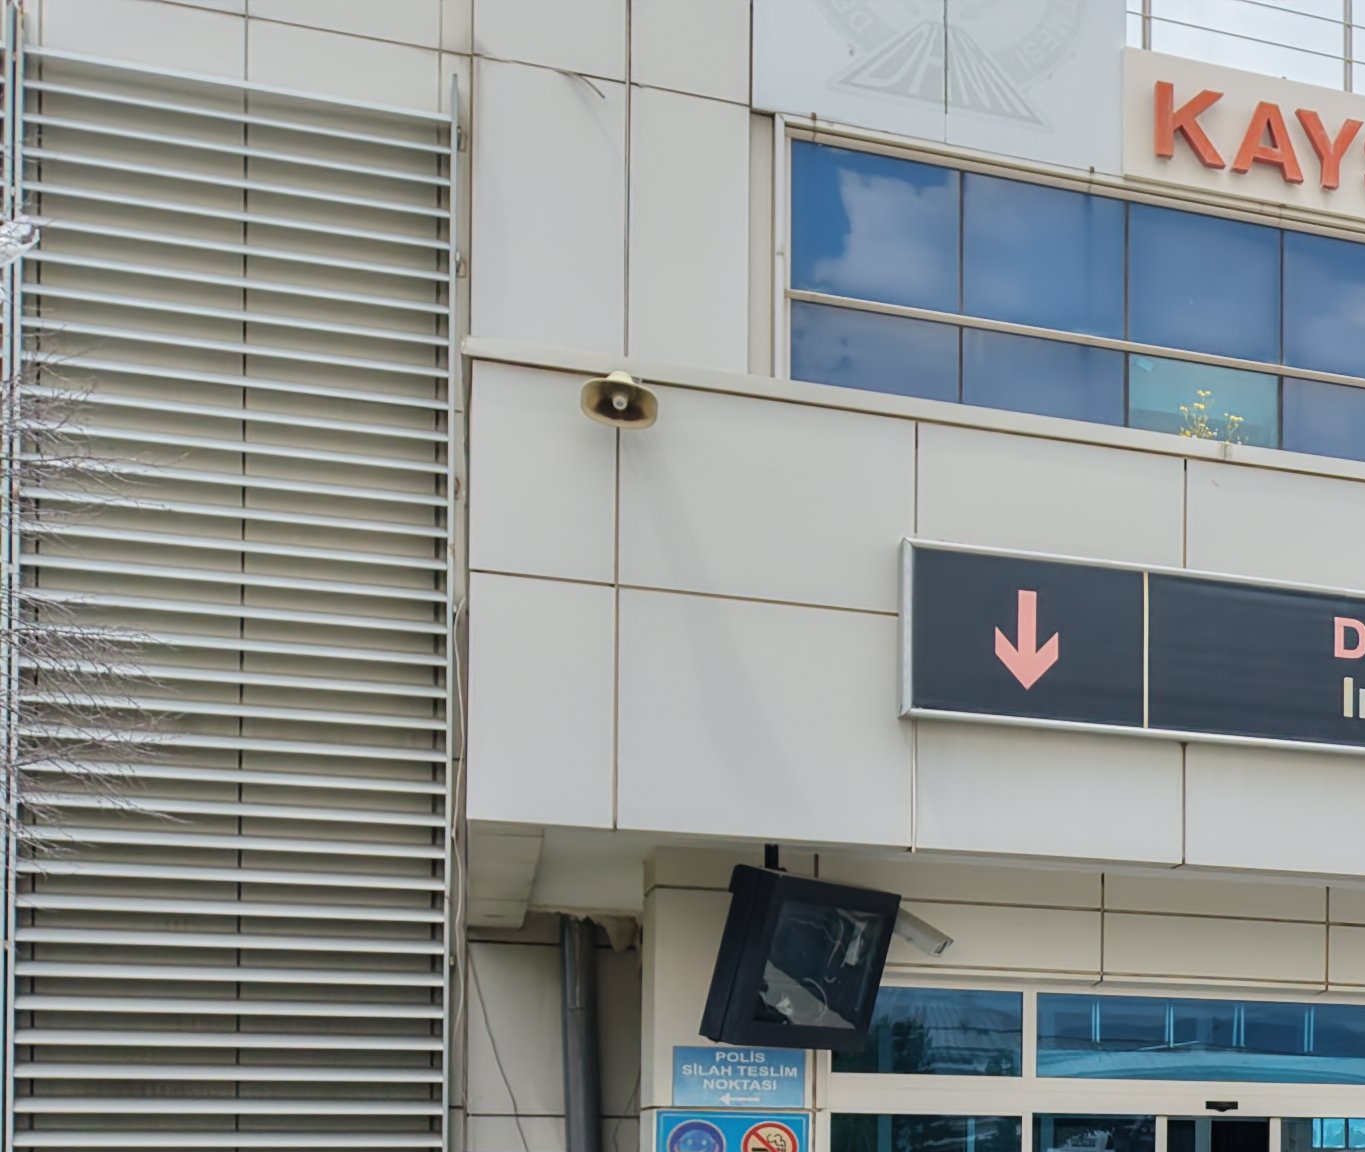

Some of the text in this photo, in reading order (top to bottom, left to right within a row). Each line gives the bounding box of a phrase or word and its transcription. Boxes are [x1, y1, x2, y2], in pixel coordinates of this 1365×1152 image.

[715, 1050, 766, 1063] POLİS
[682, 1063, 798, 1078] SİLAH TESLİM
[702, 1079, 777, 1091] NOKTASI
